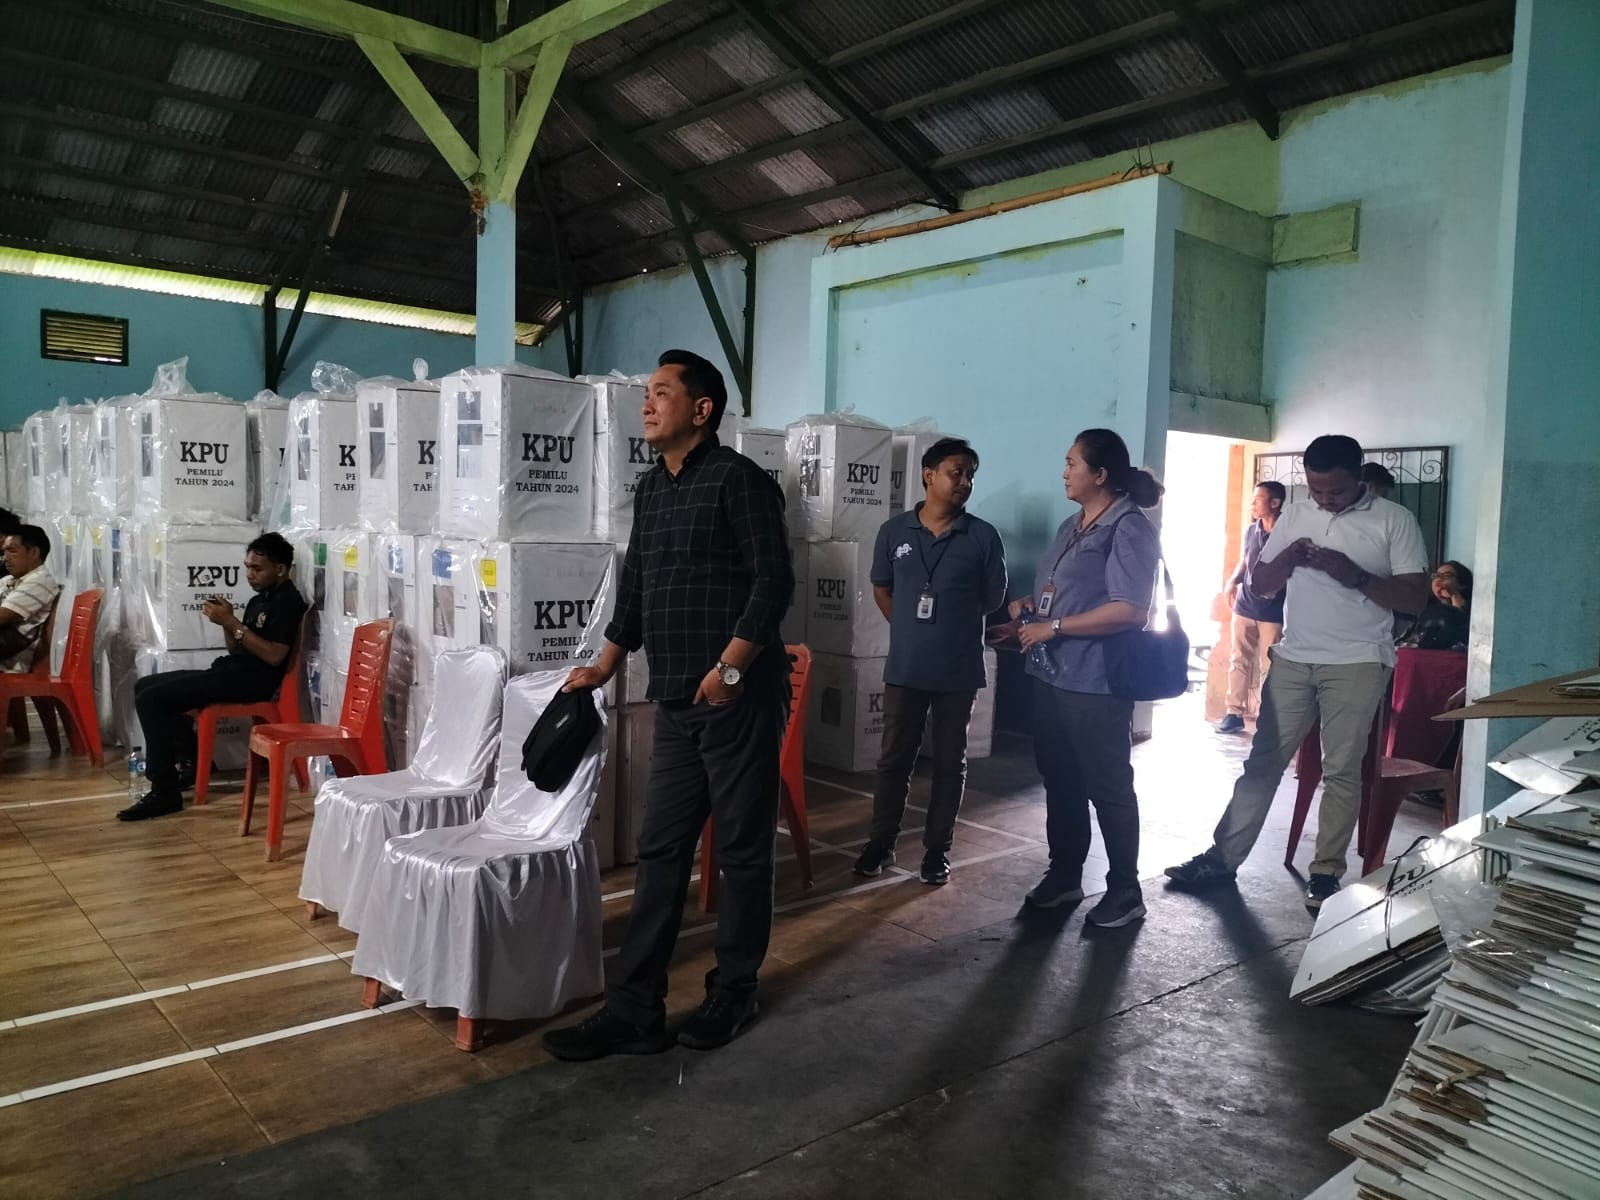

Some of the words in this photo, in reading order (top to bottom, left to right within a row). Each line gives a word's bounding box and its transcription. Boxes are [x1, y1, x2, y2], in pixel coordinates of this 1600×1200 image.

[180, 441, 230, 465] KPU
[521, 432, 576, 464] KPU
[175, 477, 209, 486] TAHUN
[211, 479, 235, 487] 2024
[187, 468, 224, 477] PEMILU
[528, 469, 568, 481] PEMILU
[847, 462, 881, 485] KPU
[515, 482, 552, 493] TAHUN
[554, 484, 580, 494] 2024
[187, 566, 240, 588] KPU
[816, 578, 846, 600] KPU
[534, 600, 596, 630] KPU
[528, 650, 570, 662] TAHUN
